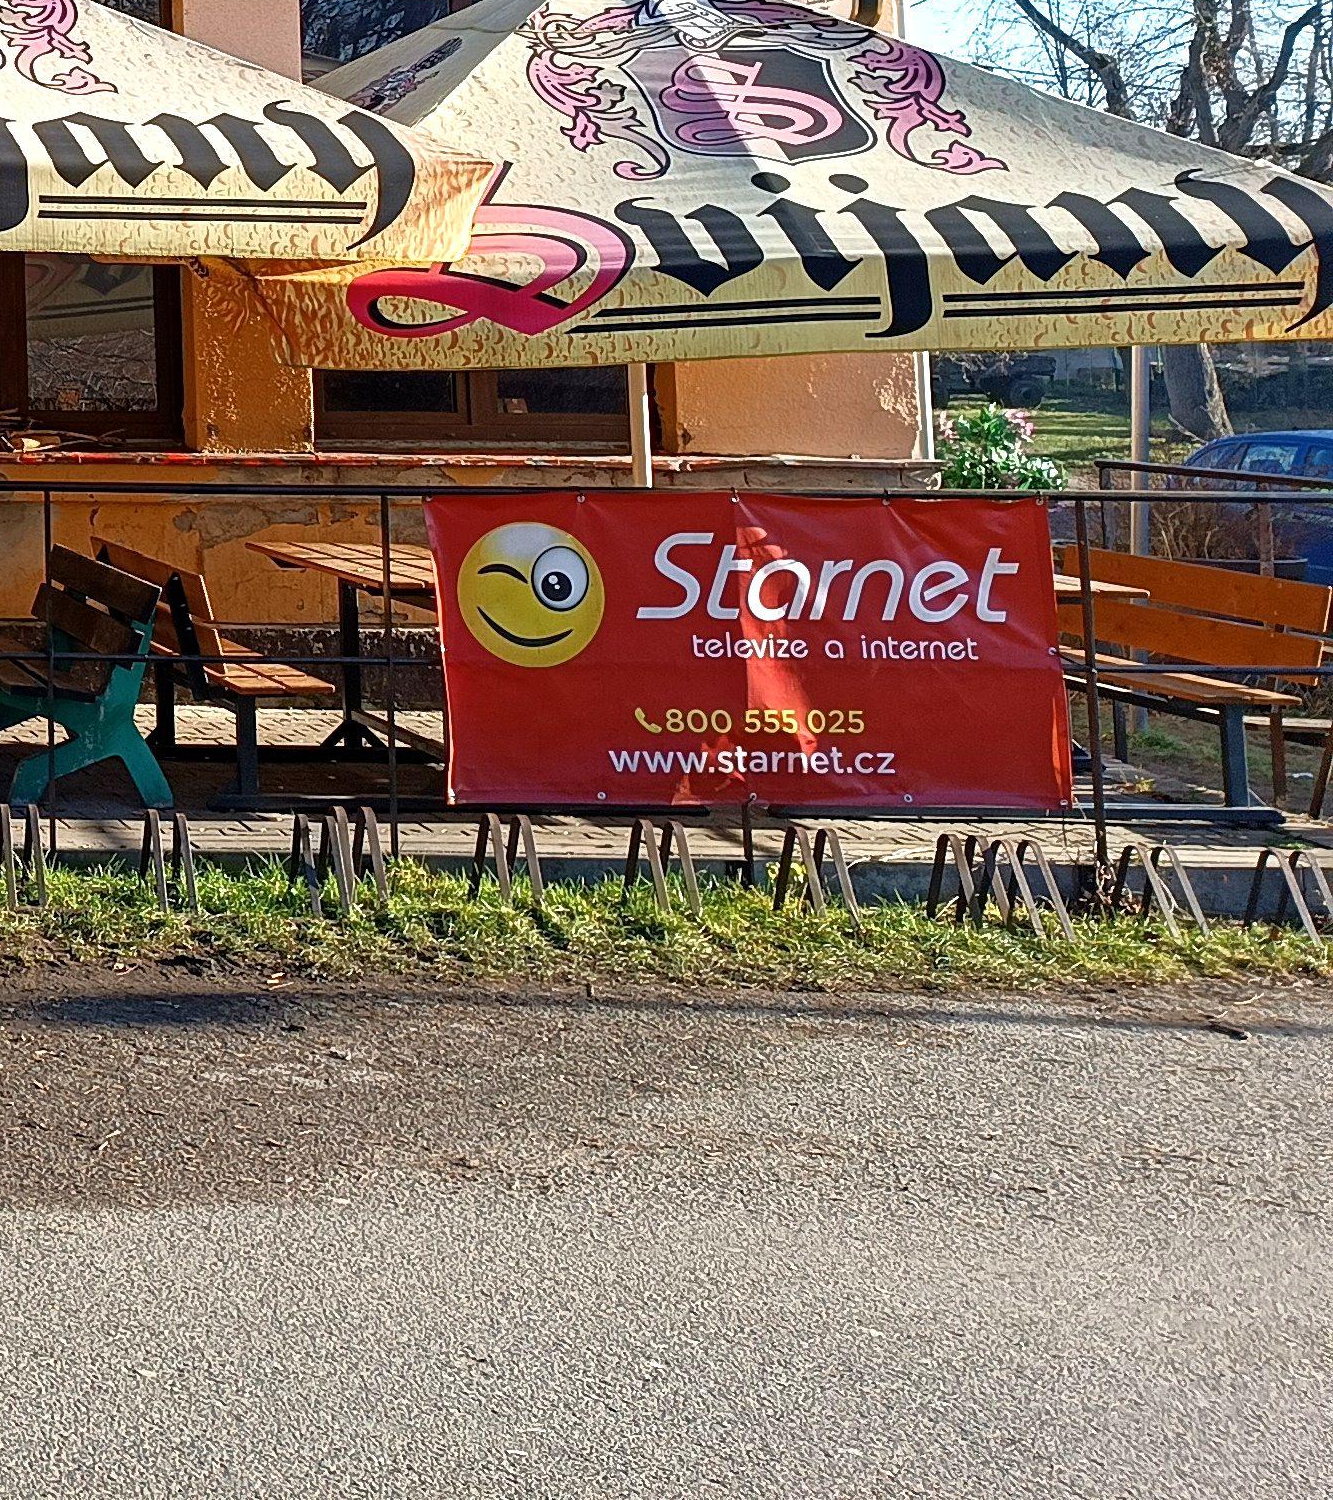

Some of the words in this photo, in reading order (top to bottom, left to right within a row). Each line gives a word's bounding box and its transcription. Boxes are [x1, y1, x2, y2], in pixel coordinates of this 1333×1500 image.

[636, 531, 1020, 623] Starnet
[691, 633, 810, 660] televize
[825, 638, 845, 660] a
[860, 635, 980, 661] internet
[665, 708, 733, 735] 800
[744, 708, 800, 735] 555
[806, 708, 866, 735] 025
[608, 745, 897, 776] www.starnet.cz
